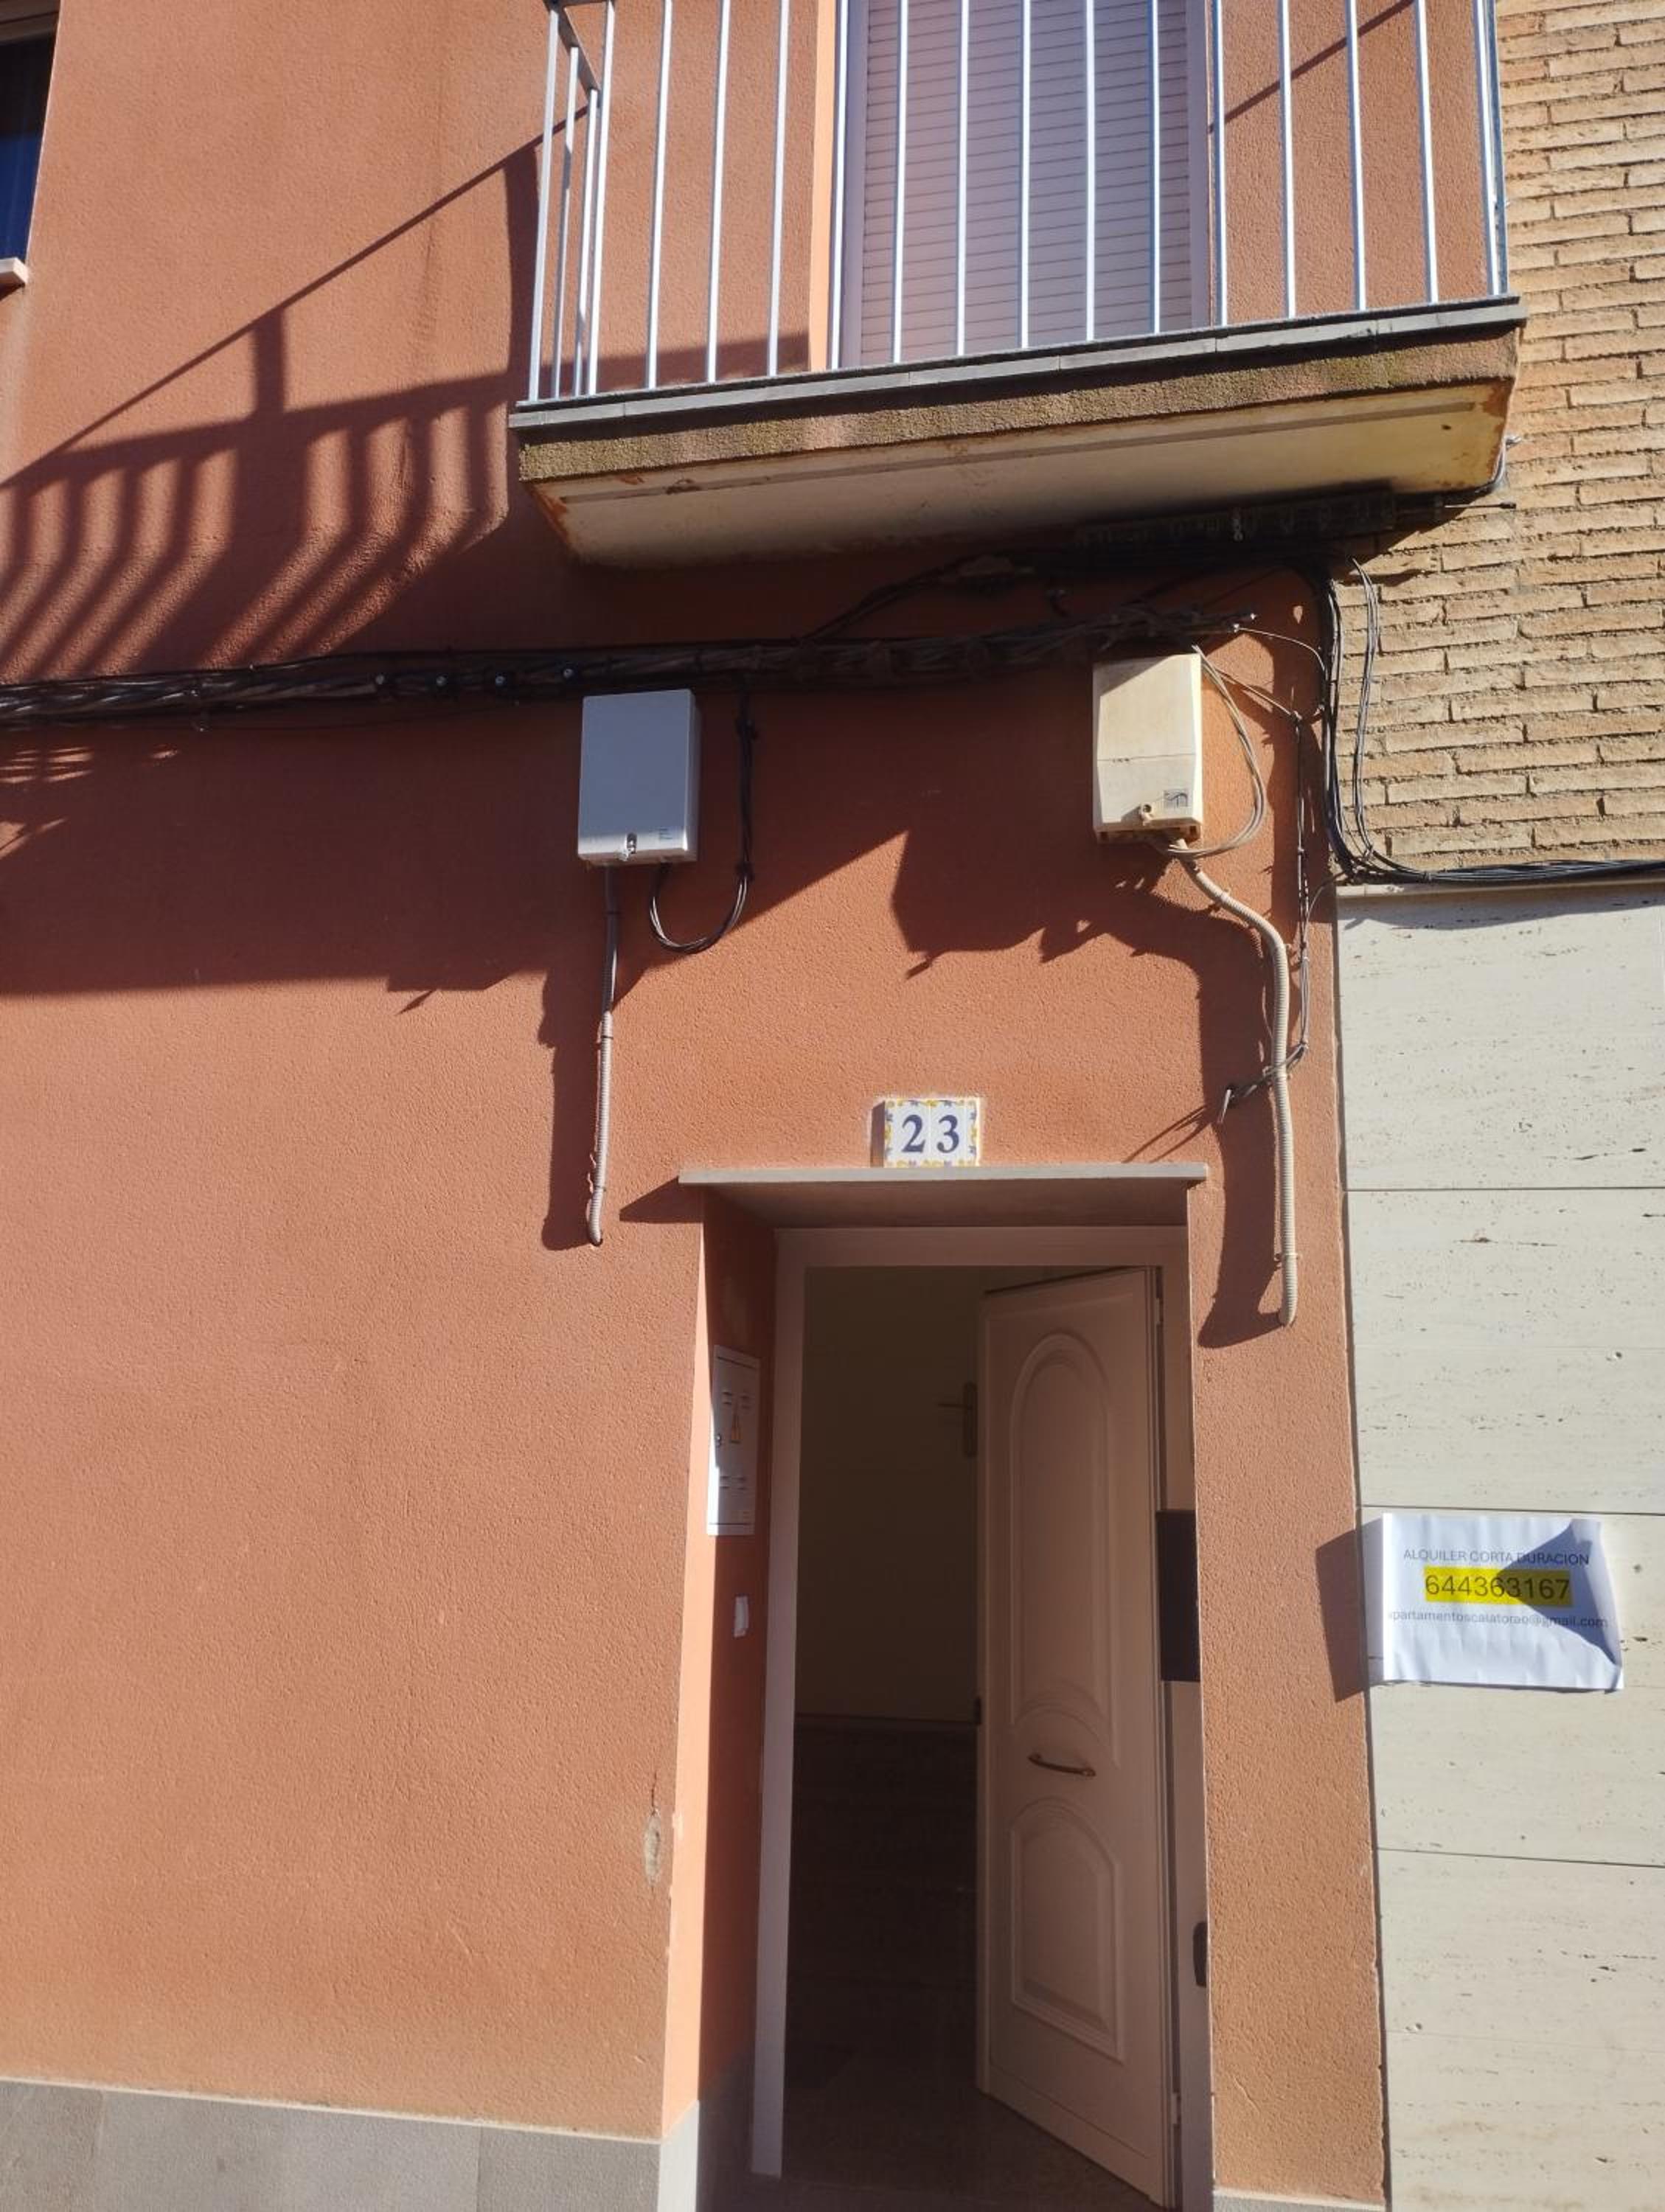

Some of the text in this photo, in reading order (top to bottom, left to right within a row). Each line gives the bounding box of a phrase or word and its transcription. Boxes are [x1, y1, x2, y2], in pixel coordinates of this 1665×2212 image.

[900, 1113, 959, 1154] 23
[1403, 1548, 1590, 1565] ALQUILER CORTA DURACION
[1425, 1574, 1570, 1600] 644363167
